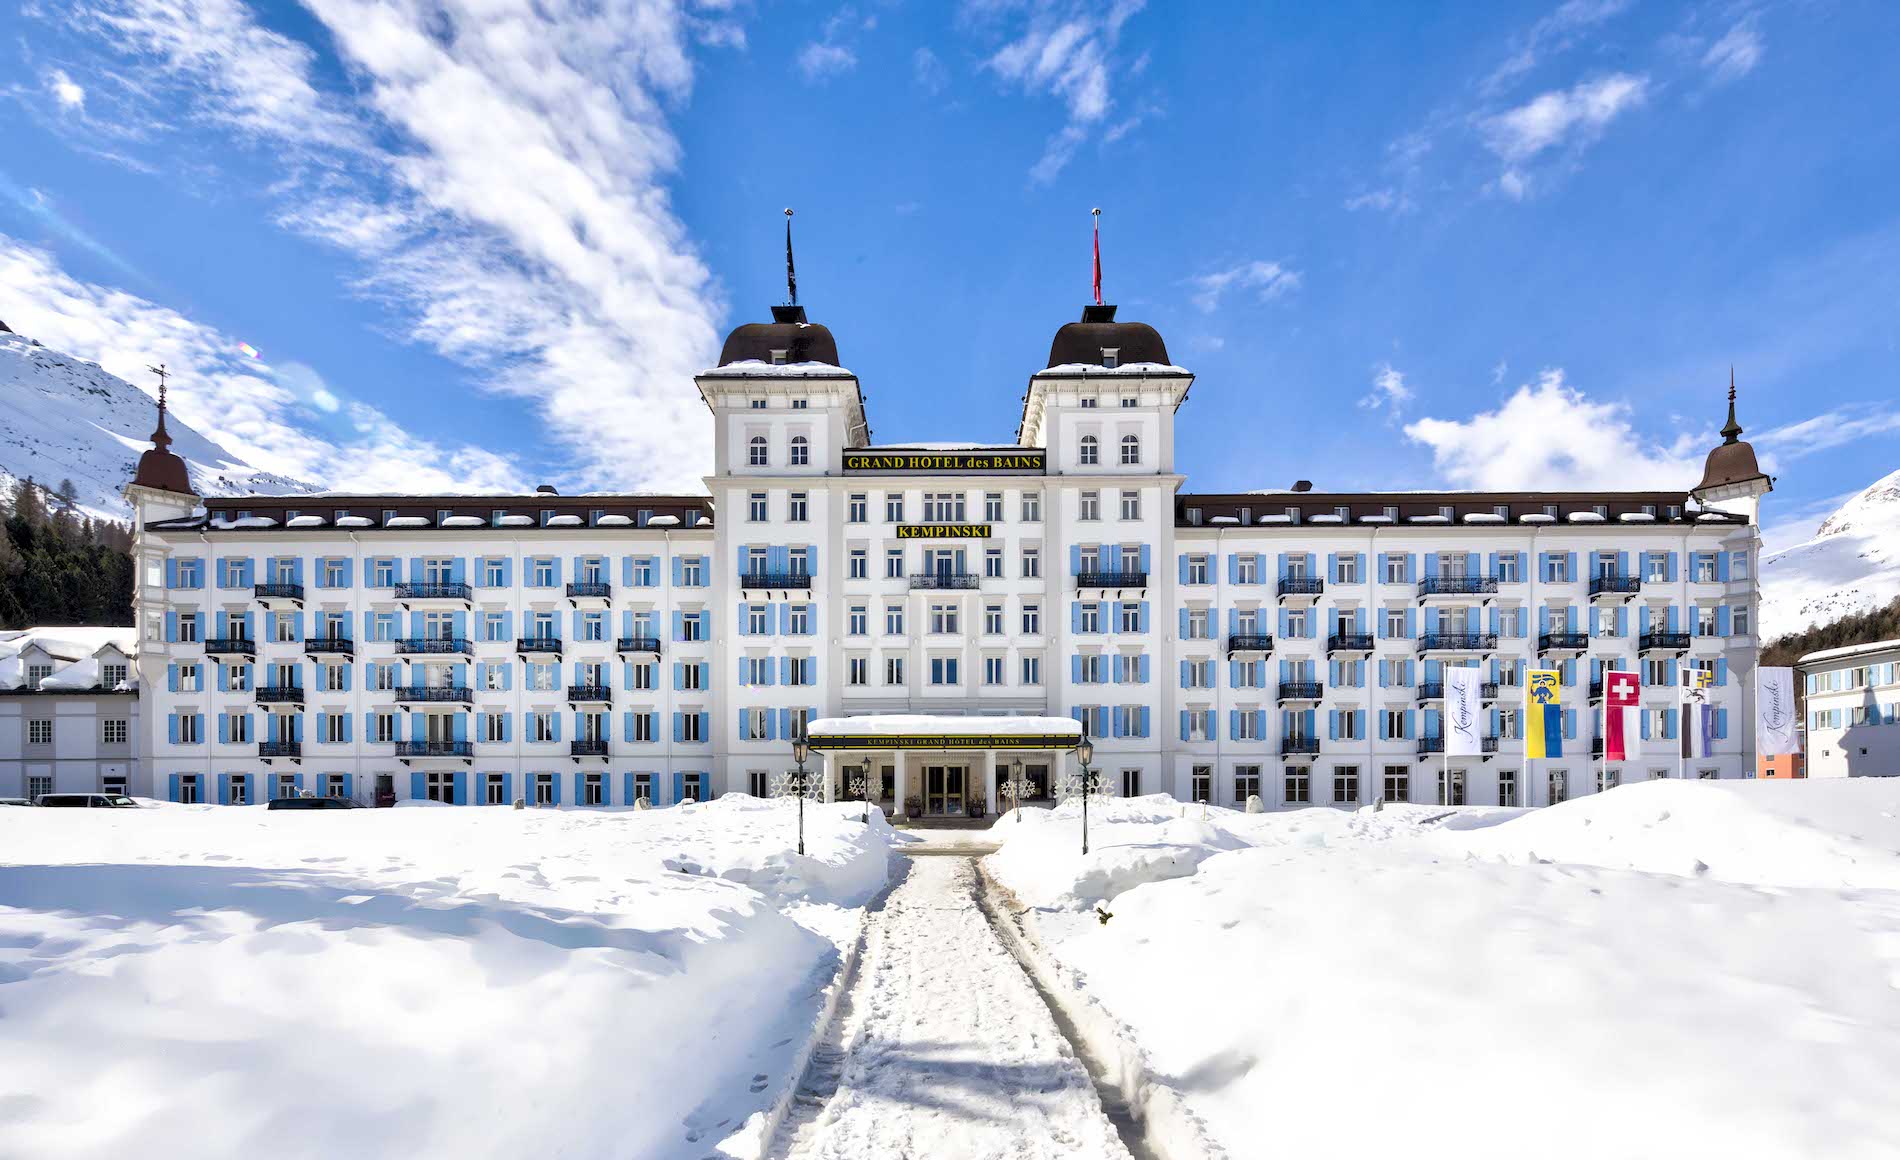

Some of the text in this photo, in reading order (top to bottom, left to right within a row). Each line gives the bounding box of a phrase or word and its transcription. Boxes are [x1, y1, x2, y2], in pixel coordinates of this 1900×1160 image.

[847, 456, 1041, 469] GRAND HOTEL des BAINS
[898, 526, 989, 538] KEMPINSKI
[1452, 680, 1474, 743] Kempinski
[1763, 680, 1788, 743] Kempinski
